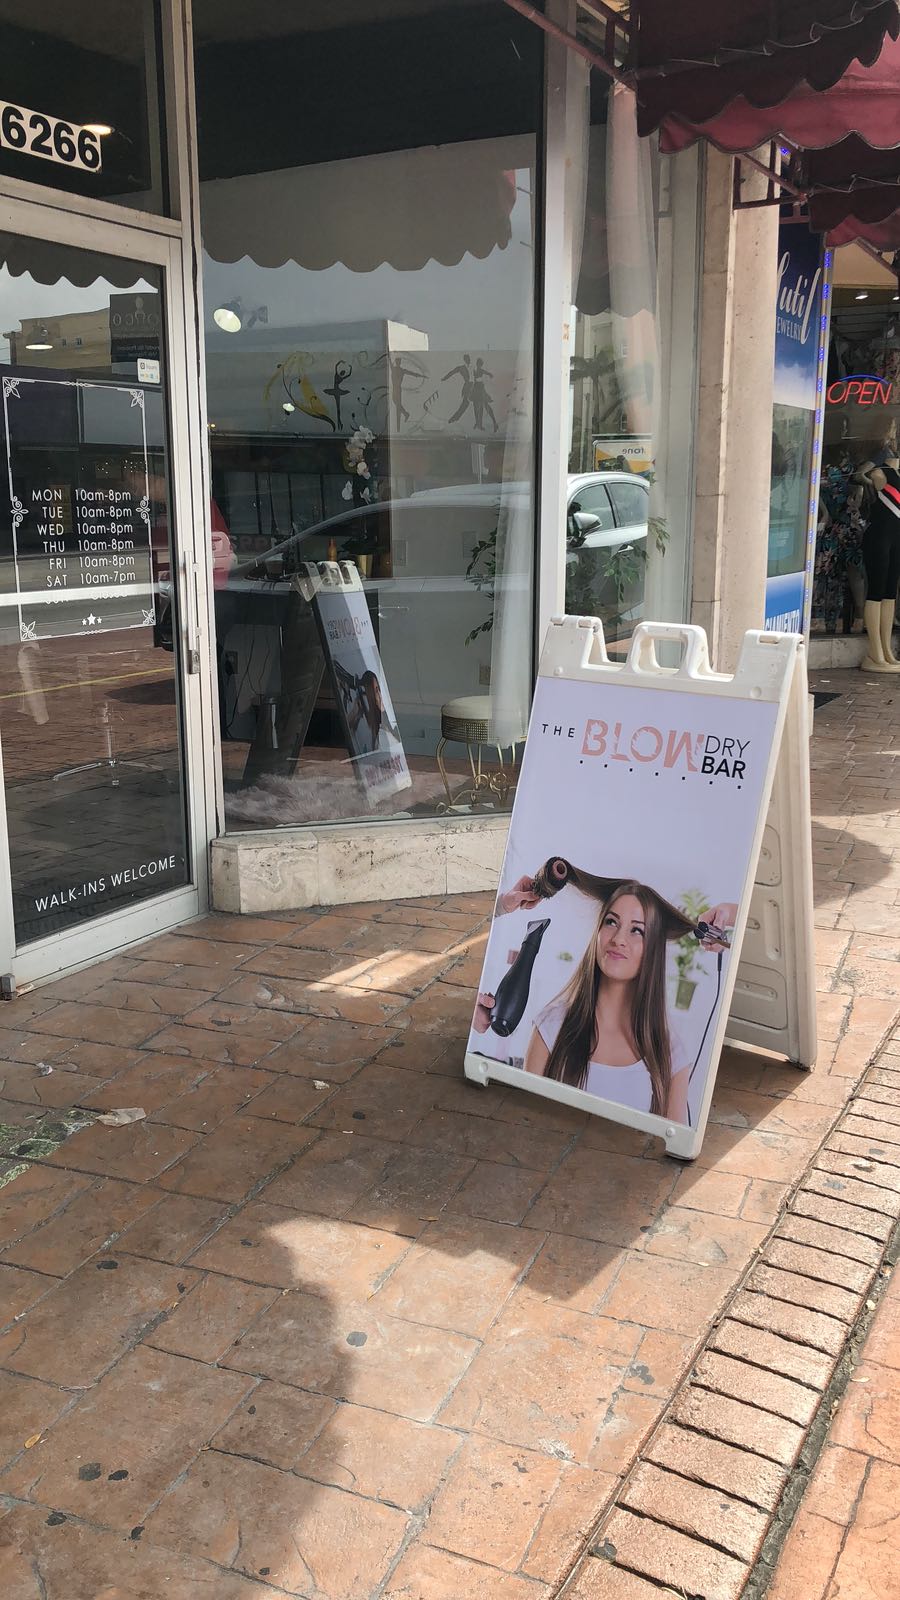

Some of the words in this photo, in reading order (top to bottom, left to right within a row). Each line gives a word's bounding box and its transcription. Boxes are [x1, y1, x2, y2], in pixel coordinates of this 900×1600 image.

[1, 105, 100, 169] 6266
[776, 316, 802, 341] EWELRY
[827, 381, 893, 405] OPEN
[32, 489, 62, 502] MON
[74, 489, 132, 503] 10am-8pm
[42, 506, 63, 519] TUE
[76, 505, 132, 520] 10am-8pm
[37, 523, 64, 536] WED
[77, 522, 133, 537] 10am-8pm
[43, 541, 65, 553] THU
[78, 539, 134, 553] 10am-8pm
[49, 557, 67, 570] FRI
[79, 555, 135, 570] 10am-8pm
[46, 574, 68, 588] SAT
[80, 571, 136, 586] 10am-7pm
[541, 723, 576, 739] THE
[580, 718, 705, 773] BLOW
[704, 735, 751, 759] DRY
[700, 755, 747, 780] BAR
[35, 878, 106, 913] WALK-INS
[110, 855, 176, 887] WELCOME
